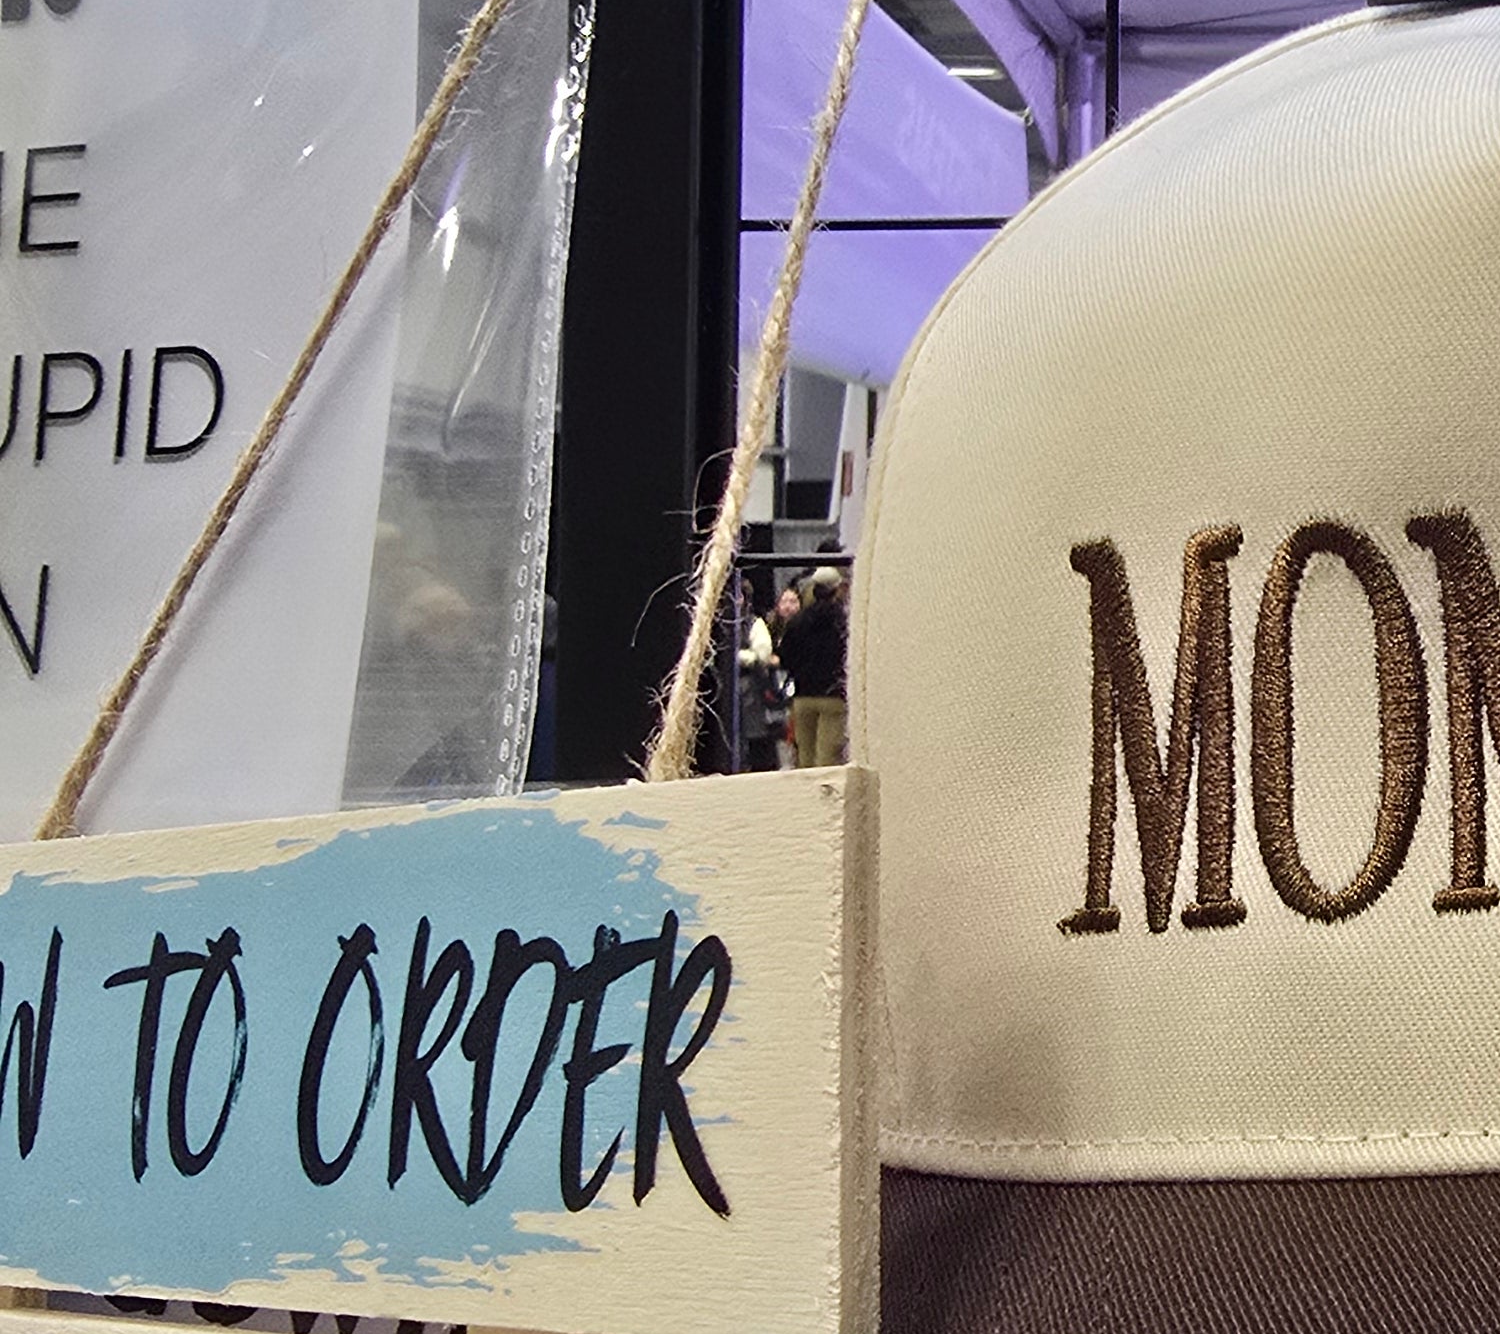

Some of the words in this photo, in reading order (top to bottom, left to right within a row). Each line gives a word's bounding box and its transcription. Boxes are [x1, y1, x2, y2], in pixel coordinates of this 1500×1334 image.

[0, 144, 87, 255] E
[103, 926, 248, 1184] TO
[296, 909, 733, 1221] ORDER
